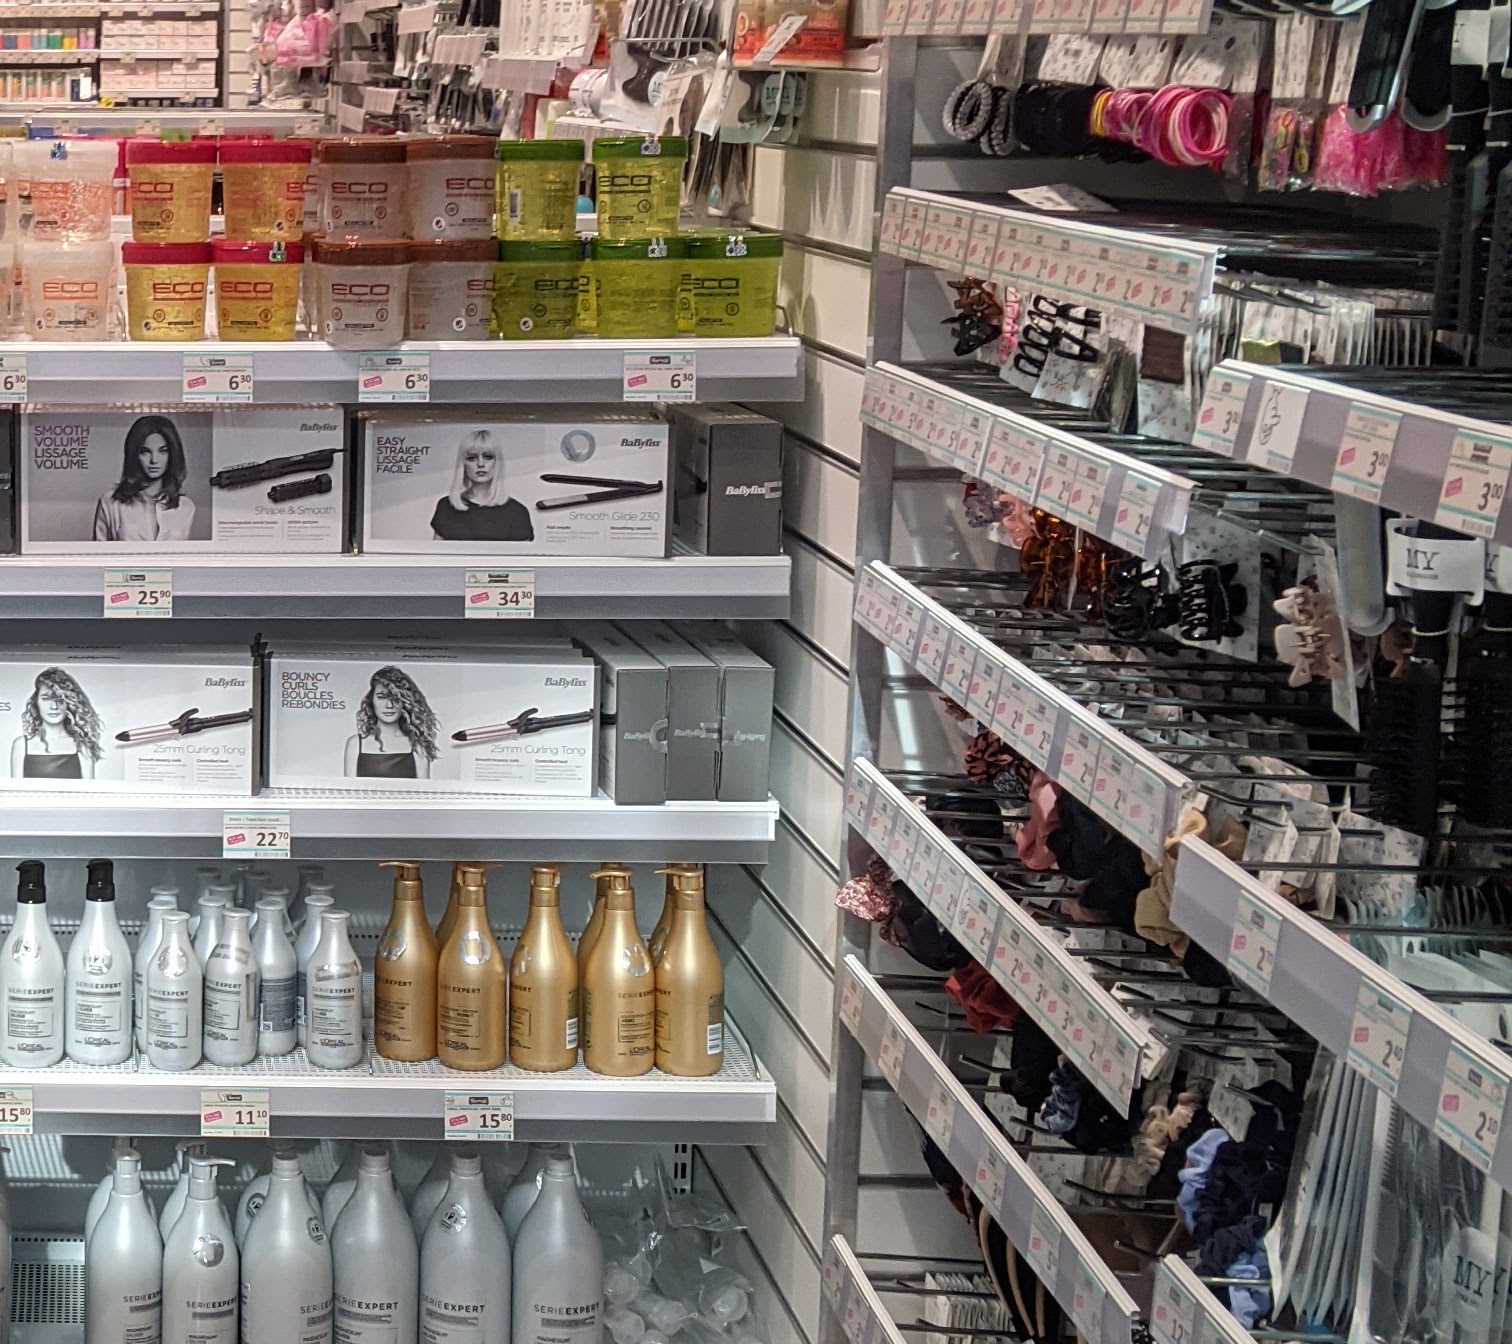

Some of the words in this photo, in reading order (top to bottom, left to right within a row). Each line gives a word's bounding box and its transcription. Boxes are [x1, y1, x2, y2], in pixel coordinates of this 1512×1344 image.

[331, 182, 387, 194] ECO
[43, 282, 97, 293] ECO
[153, 282, 204, 294] ECO
[331, 284, 389, 295] ECO
[535, 279, 590, 291] ECO
[692, 278, 740, 290] ECO
[34, 426, 89, 436] SMOOTH
[34, 437, 88, 447] VOLUME
[376, 437, 406, 446] EASY
[620, 438, 661, 449] BaByliss
[34, 448, 86, 458] LISSAGE
[376, 446, 431, 456] STRAIGHT
[34, 459, 88, 470] VOLUME
[376, 455, 421, 465] LISSAGE
[376, 464, 413, 474] FACILE
[254, 506, 285, 516] Shape
[298, 505, 336, 515] Smooth
[569, 511, 609, 521] Smooth
[611, 511, 638, 521] Glide
[641, 512, 659, 521] 230
[282, 672, 330, 682] BOUNCY
[544, 677, 587, 688] BaByliss
[205, 678, 246, 689] BaByliss
[282, 681, 318, 691] CURLS
[282, 691, 333, 700] BOUCLES
[282, 700, 346, 710] REBONDIES
[153, 745, 184, 755] 25mm
[186, 744, 220, 756] Curling
[222, 745, 246, 756] Tong
[490, 744, 521, 754] 25mm
[524, 744, 558, 756] Curling
[560, 744, 586, 756] Tong
